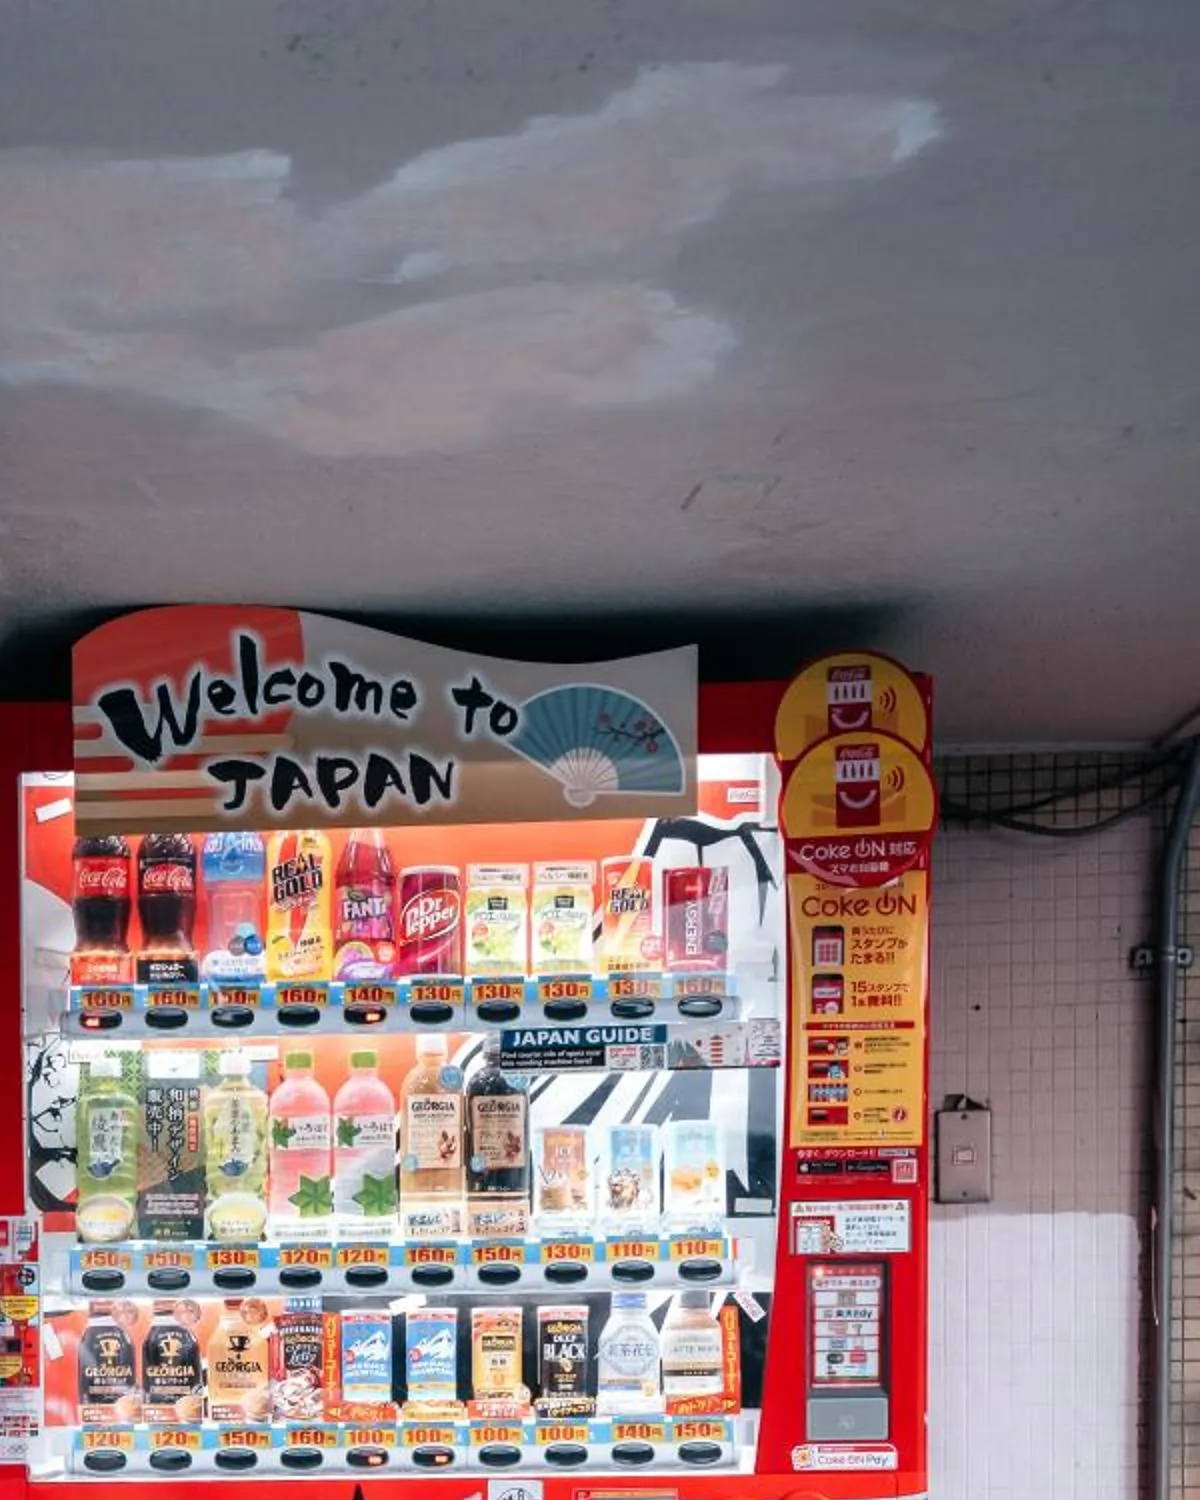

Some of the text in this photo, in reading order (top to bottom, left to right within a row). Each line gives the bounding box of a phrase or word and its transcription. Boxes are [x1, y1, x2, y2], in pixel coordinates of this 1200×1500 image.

[99, 635, 519, 762] Welcome to
[207, 753, 454, 811] JAPAN
[800, 844, 850, 861] Coke
[272, 853, 318, 885] REAL
[273, 868, 324, 903] GOLD
[418, 896, 443, 917] Dr
[801, 891, 917, 917] Coke ON
[406, 903, 455, 937] Pepper
[512, 1027, 652, 1047] JAPAN GUIDE
[411, 1101, 456, 1114] GEORGIA
[543, 1343, 586, 1360] BLACK
[146, 1364, 195, 1378] GEORGIA
[215, 1358, 263, 1374] GEORGIA
